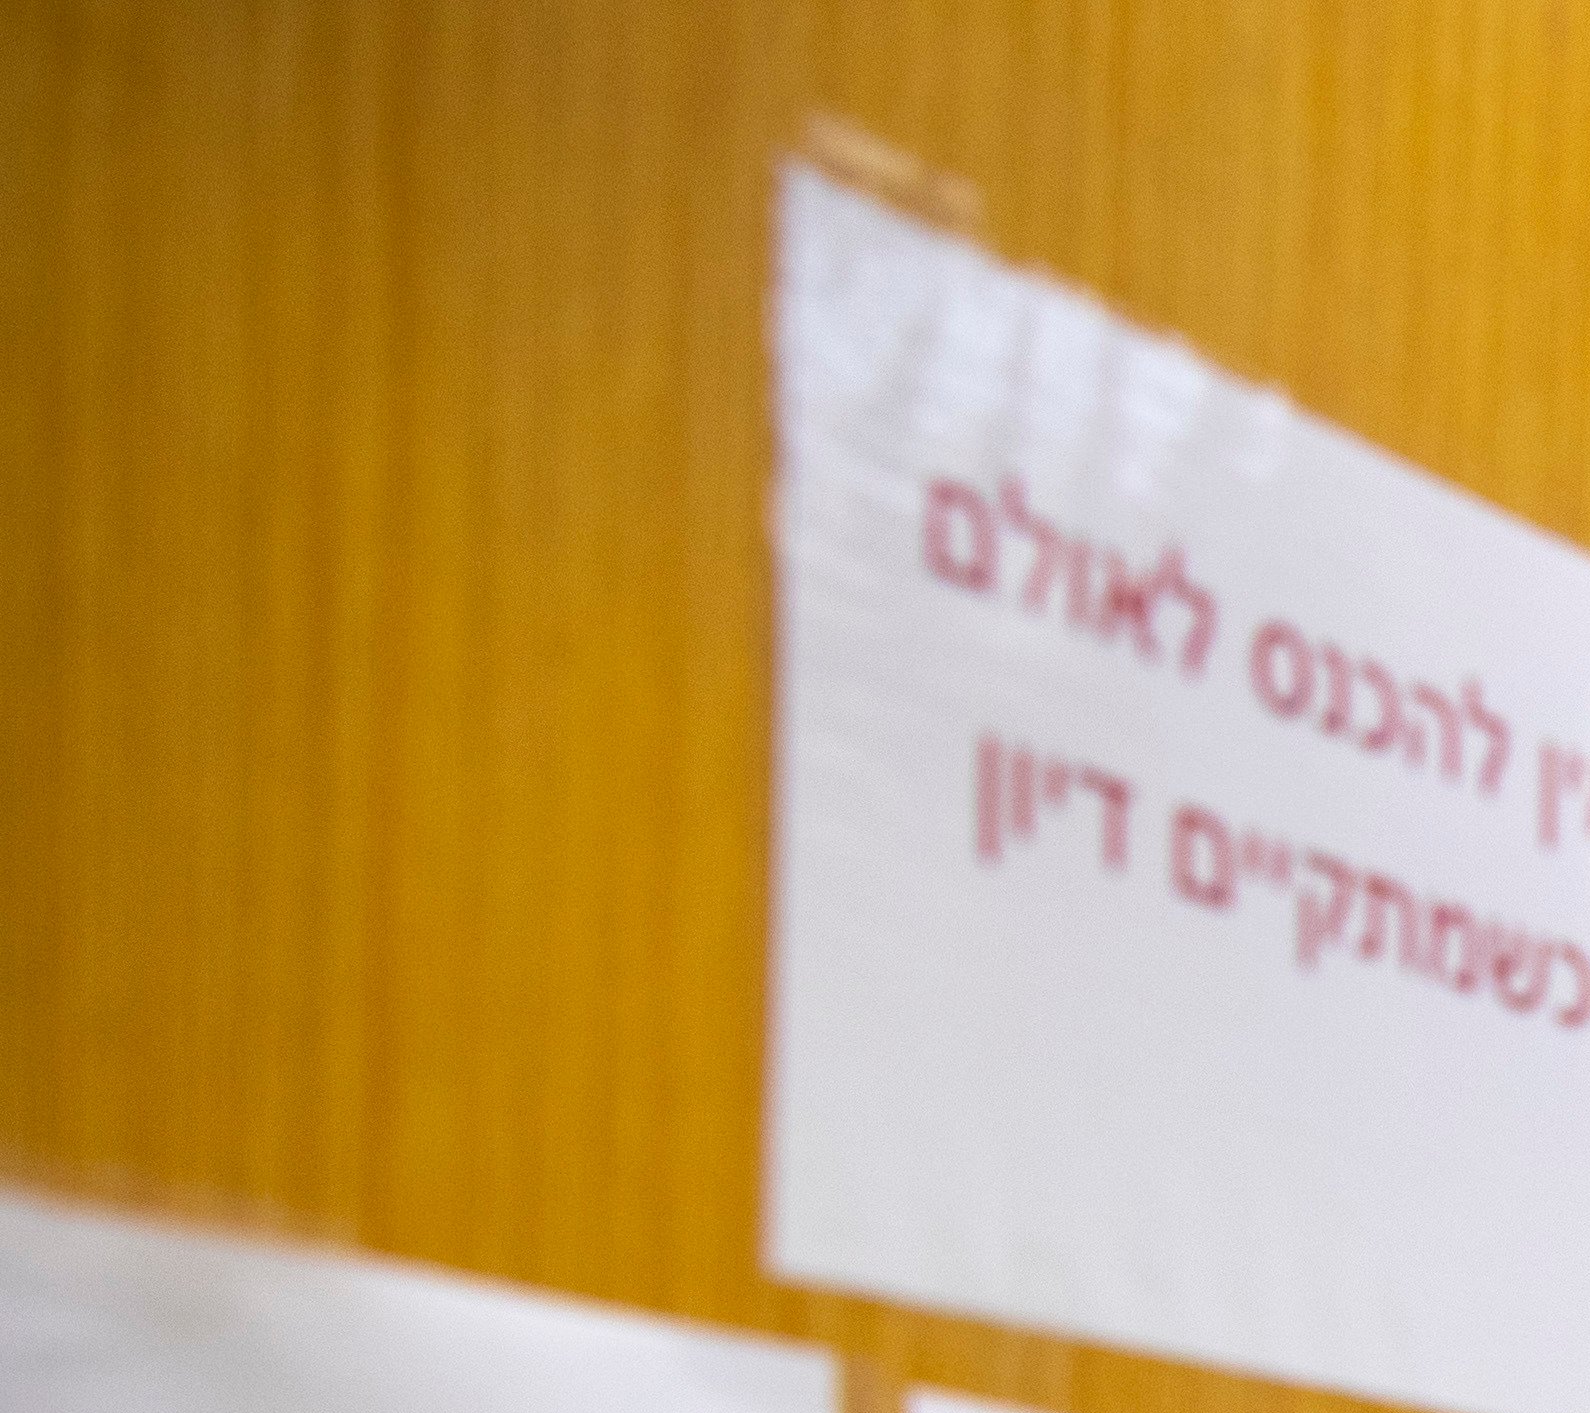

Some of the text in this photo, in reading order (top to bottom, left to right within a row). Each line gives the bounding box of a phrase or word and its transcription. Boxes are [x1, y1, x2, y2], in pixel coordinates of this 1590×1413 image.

[921, 470, 1220, 680] לאולם
[1249, 617, 1514, 796] להכנס
[975, 730, 1135, 868] דיון
